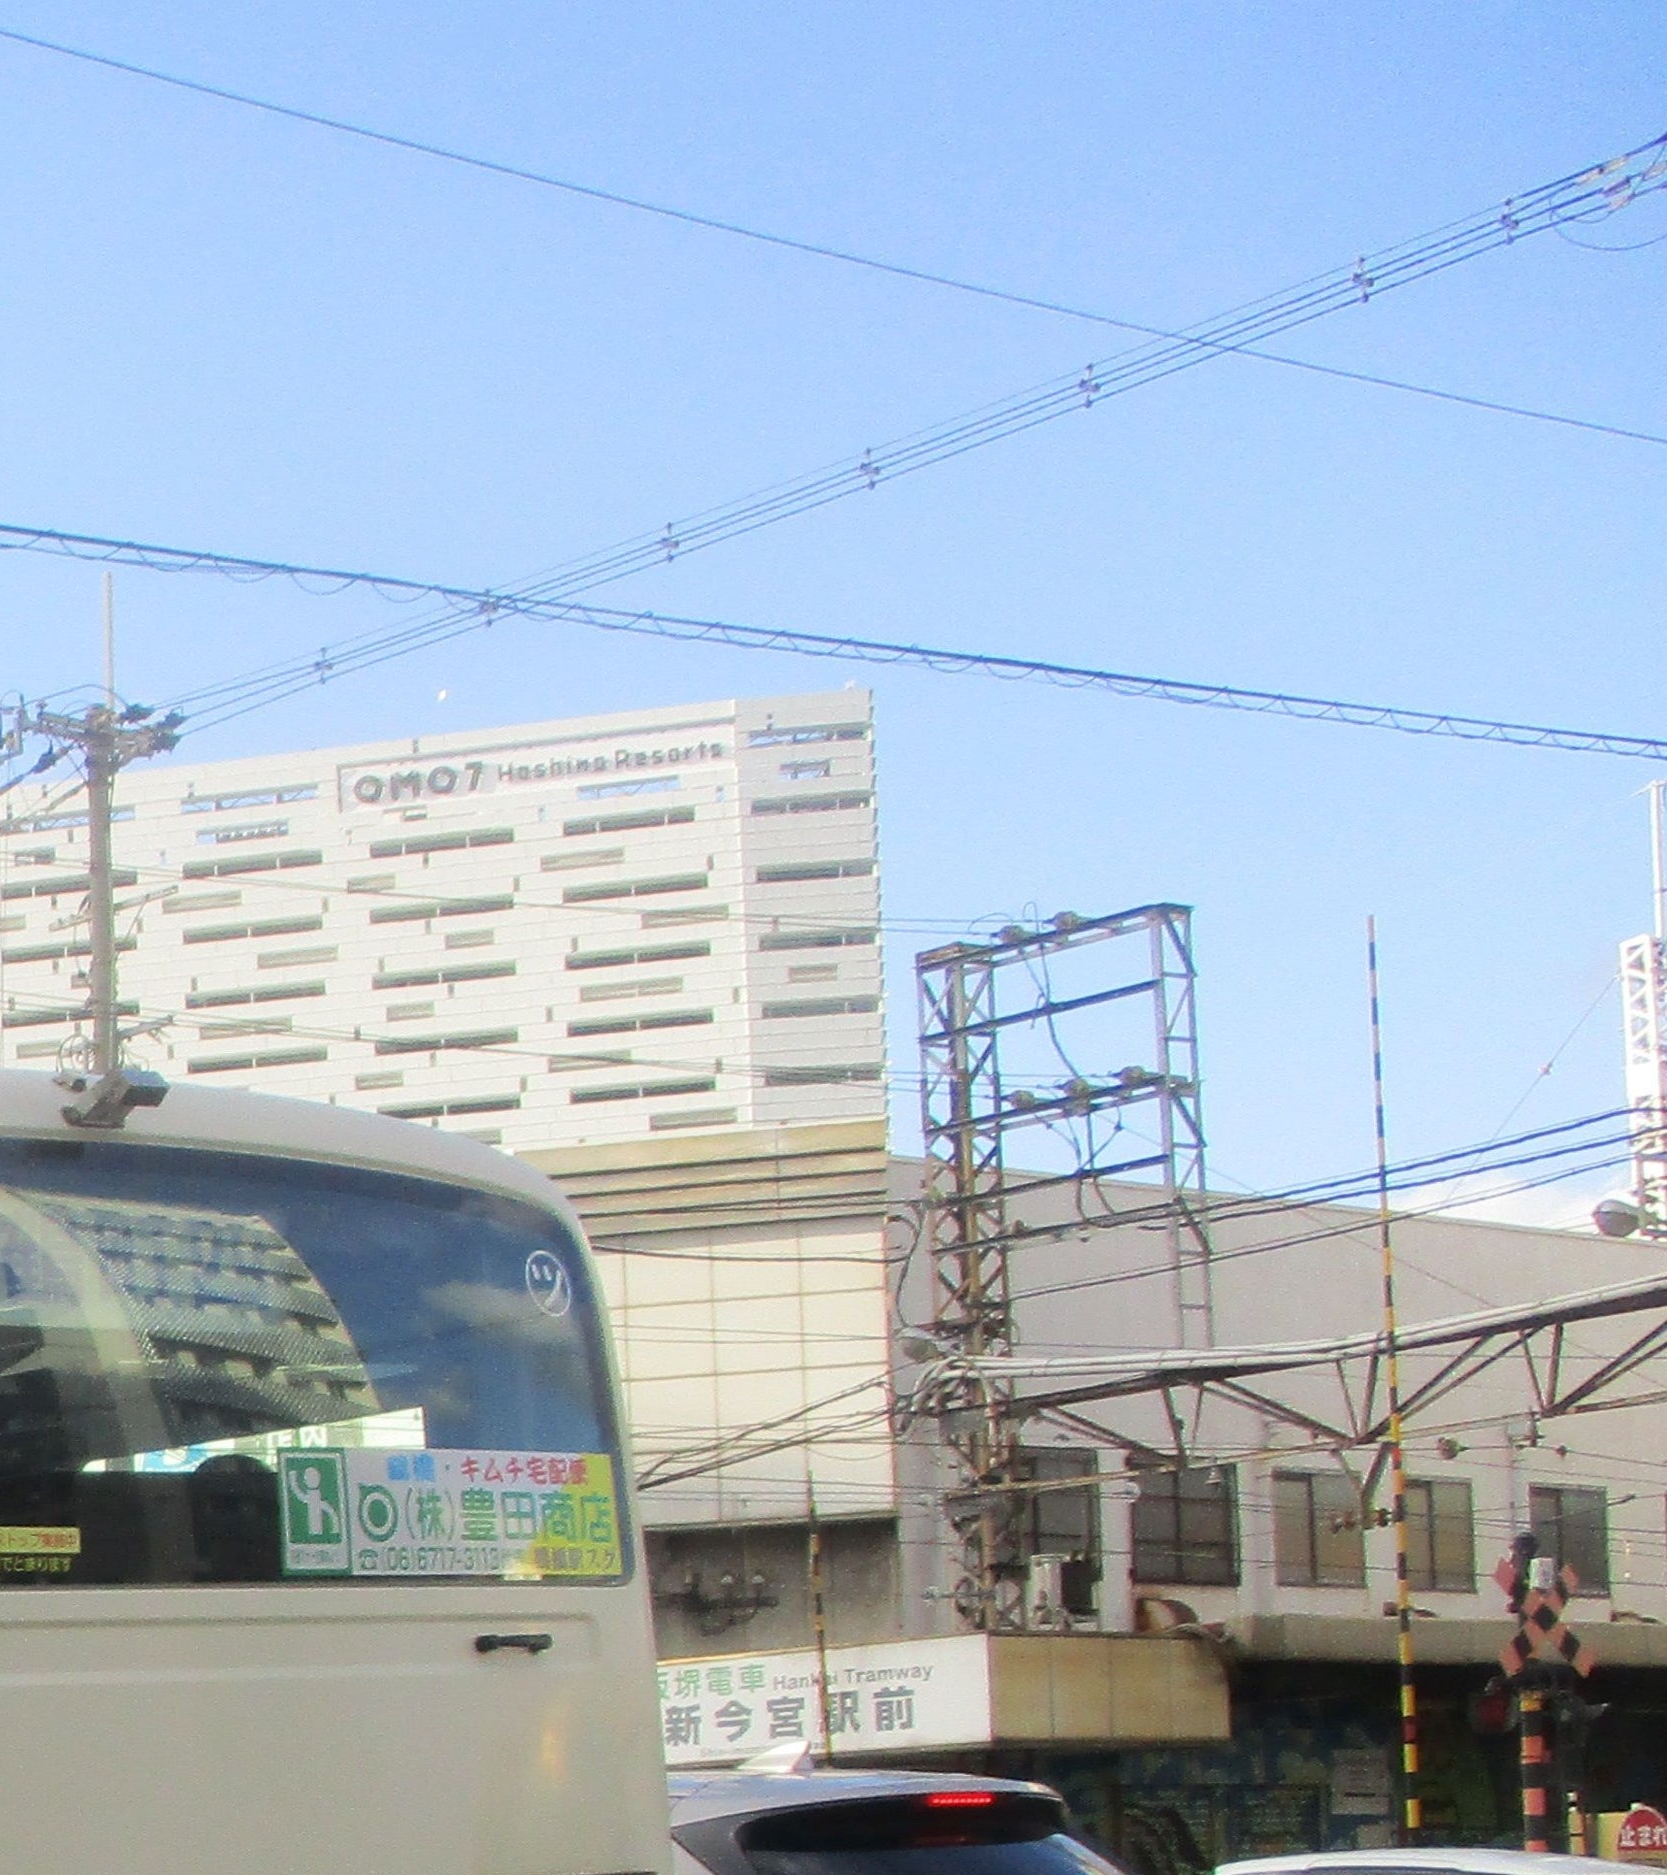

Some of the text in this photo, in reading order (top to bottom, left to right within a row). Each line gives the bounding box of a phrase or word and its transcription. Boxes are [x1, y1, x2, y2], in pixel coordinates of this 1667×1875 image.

[354, 761, 483, 803] OMO7
[615, 741, 724, 769] Resorts
[844, 1665, 934, 1683] Tramway
[665, 1686, 916, 1746] 新今宮駅前
[1619, 1825, 1667, 1848] 止まれ
